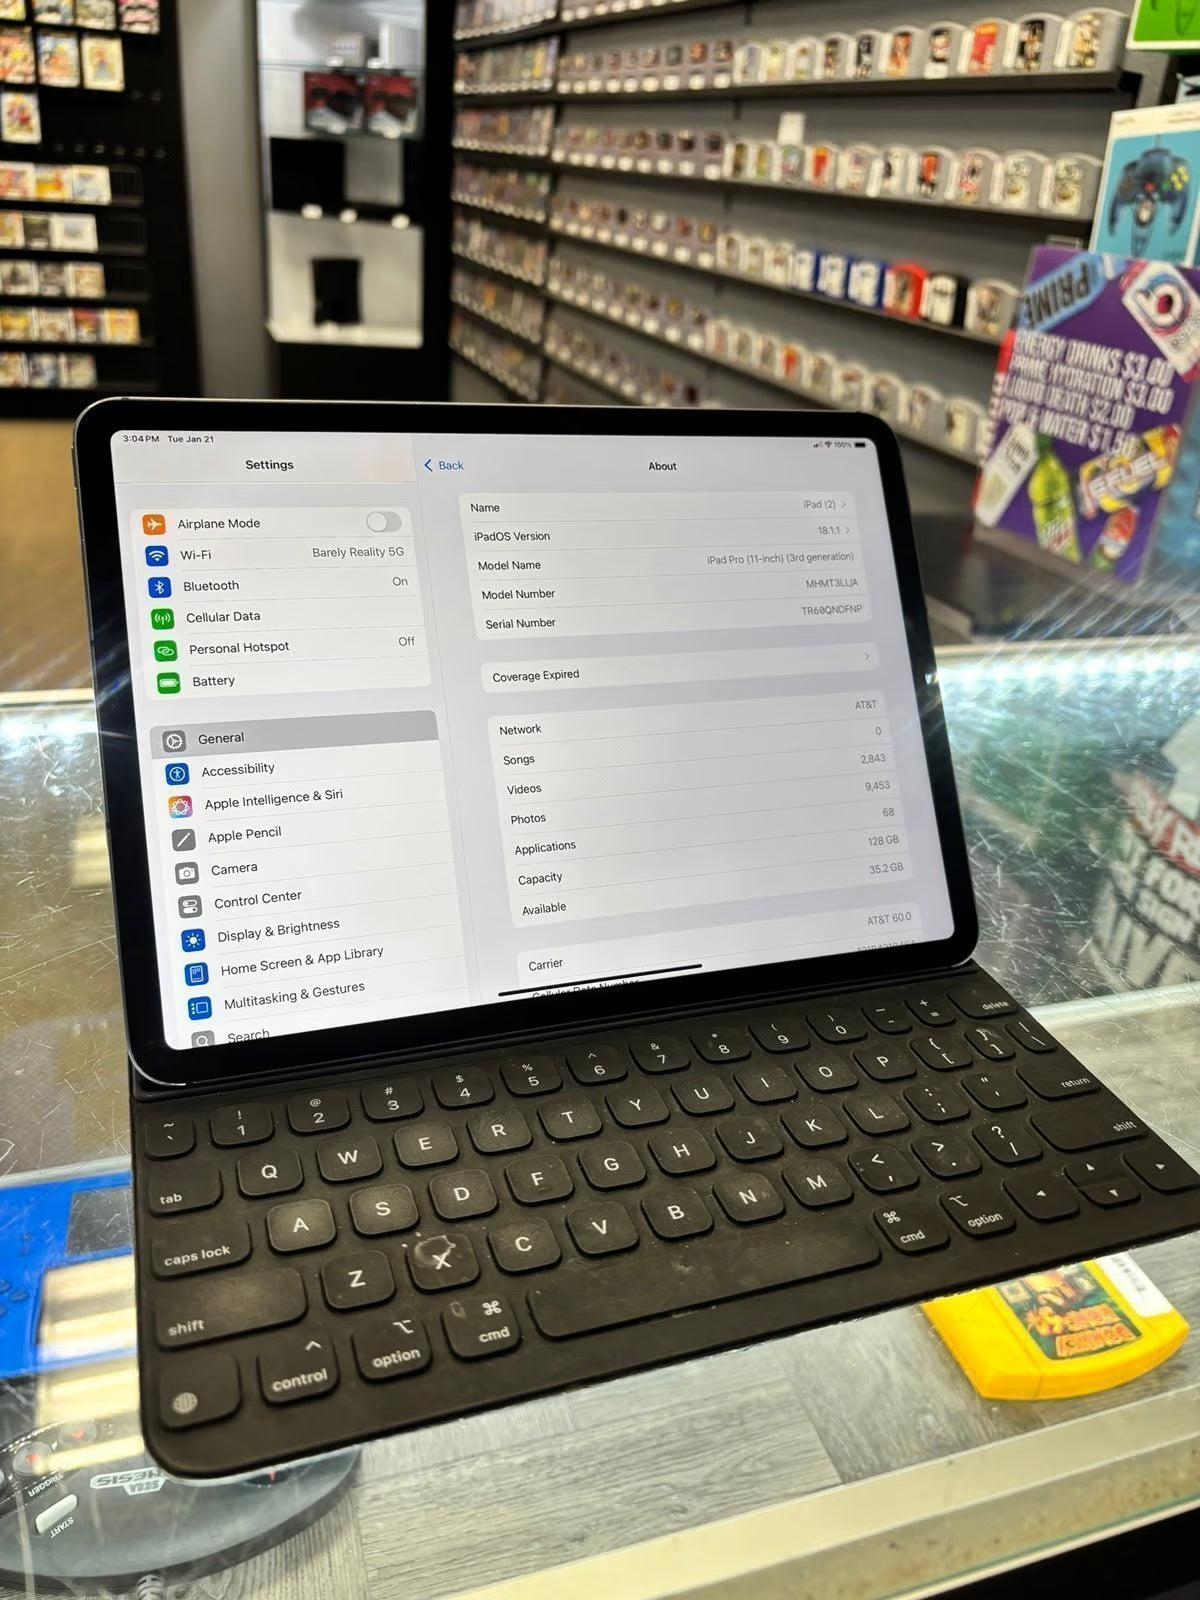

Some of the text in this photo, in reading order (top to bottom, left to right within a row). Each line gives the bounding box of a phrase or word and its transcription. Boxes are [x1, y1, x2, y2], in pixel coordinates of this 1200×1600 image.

[1065, 339, 1124, 375] DRINKS
[1124, 380, 1175, 414] $3.00
[1048, 385, 1090, 417] DEATH
[1088, 399, 1136, 431] $2.00
[1038, 408, 1090, 446] WATER
[245, 460, 294, 472] Settings
[439, 461, 464, 470] Back
[649, 462, 677, 471] About
[470, 503, 500, 512] Name
[803, 499, 836, 510] iPad (2)
[178, 518, 260, 531] Airplane Mode
[818, 526, 840, 535] 18.1.1
[474, 531, 550, 541] iPadOS Version
[180, 549, 211, 560] Wi-Fi
[312, 546, 404, 559] Barely Reality 5G
[707, 552, 854, 565] iPad Pro (11-inch) (3rd generation)
[478, 561, 541, 570] Model Name
[183, 580, 239, 591] Bluetooth
[392, 576, 408, 586] On
[482, 589, 555, 600] Model Number
[186, 611, 260, 623] Cellular Data
[485, 618, 556, 630] Serial Number
[398, 636, 415, 646] Off
[189, 642, 290, 655] Personal Hotspot
[193, 677, 235, 687] Battery
[492, 669, 580, 683] Coverage Expired
[855, 700, 877, 709] AT&T
[499, 724, 542, 735] Network
[875, 726, 882, 736] 0
[198, 732, 244, 745] General
[503, 755, 535, 766] Songs
[861, 753, 886, 765] 2,843
[202, 762, 275, 777] Accessibility
[506, 784, 542, 795] Videos
[865, 780, 890, 792] 9,453
[205, 789, 343, 811] Apple Intelligence & Siri
[882, 807, 895, 817] 68
[511, 814, 546, 825] Photos
[208, 826, 282, 844] Apple Pencil
[868, 835, 899, 846] 128 GB
[515, 841, 576, 856] Applications
[211, 864, 258, 876] Camera
[869, 862, 904, 875] 35.2 GB
[518, 872, 562, 886] Capacity
[214, 892, 302, 909] Control Center
[522, 902, 567, 916] Available
[867, 911, 912, 926] AT&T 60.0
[218, 920, 340, 944] Display & Brightness
[221, 947, 383, 976] Home Screen & App Library
[528, 958, 563, 971] Carrier
[224, 983, 365, 1010] Multitasking & Gestures
[982, 1001, 1009, 1010] delete
[227, 1028, 270, 1043] Search
[835, 1026, 847, 1034] 0
[777, 1035, 789, 1044] 9
[718, 1045, 730, 1054] 8
[657, 1054, 665, 1064] 7
[876, 1056, 888, 1067] P
[594, 1065, 605, 1075] 6
[528, 1076, 539, 1086] 5
[1061, 1078, 1090, 1088] return
[460, 1088, 471, 1097] 4
[694, 1088, 709, 1099] U
[388, 1100, 399, 1110] 3
[629, 1099, 641, 1111] Y
[313, 1112, 325, 1123] 2
[561, 1111, 573, 1123] T
[868, 1108, 884, 1119] L
[237, 1125, 245, 1135] 1
[491, 1124, 506, 1137] R
[805, 1119, 822, 1132] K
[1113, 1121, 1137, 1131] shift
[418, 1137, 432, 1150] E
[746, 1132, 756, 1144] J
[337, 1150, 358, 1164] W
[673, 1144, 690, 1158] H
[604, 1158, 619, 1171] G
[261, 1165, 278, 1179] Q
[531, 1172, 544, 1186] F
[806, 1175, 827, 1190] M
[160, 1193, 182, 1204] tab
[453, 1187, 470, 1201] D
[739, 1189, 757, 1204] N
[375, 1201, 391, 1216] S
[667, 1205, 685, 1220] B
[293, 1217, 309, 1233] A
[968, 1213, 1003, 1227] option
[591, 1219, 607, 1235] V
[900, 1230, 926, 1243] cmd
[515, 1236, 532, 1251] C
[164, 1245, 231, 1266] caps lock
[432, 1254, 452, 1270] X
[348, 1270, 366, 1288] Z
[168, 1320, 204, 1336] shift
[479, 1326, 510, 1342] cmd
[372, 1349, 421, 1368] option
[272, 1368, 327, 1392] control
[28, 1472, 65, 1497] TRIGGER
[50, 1516, 74, 1538] START
